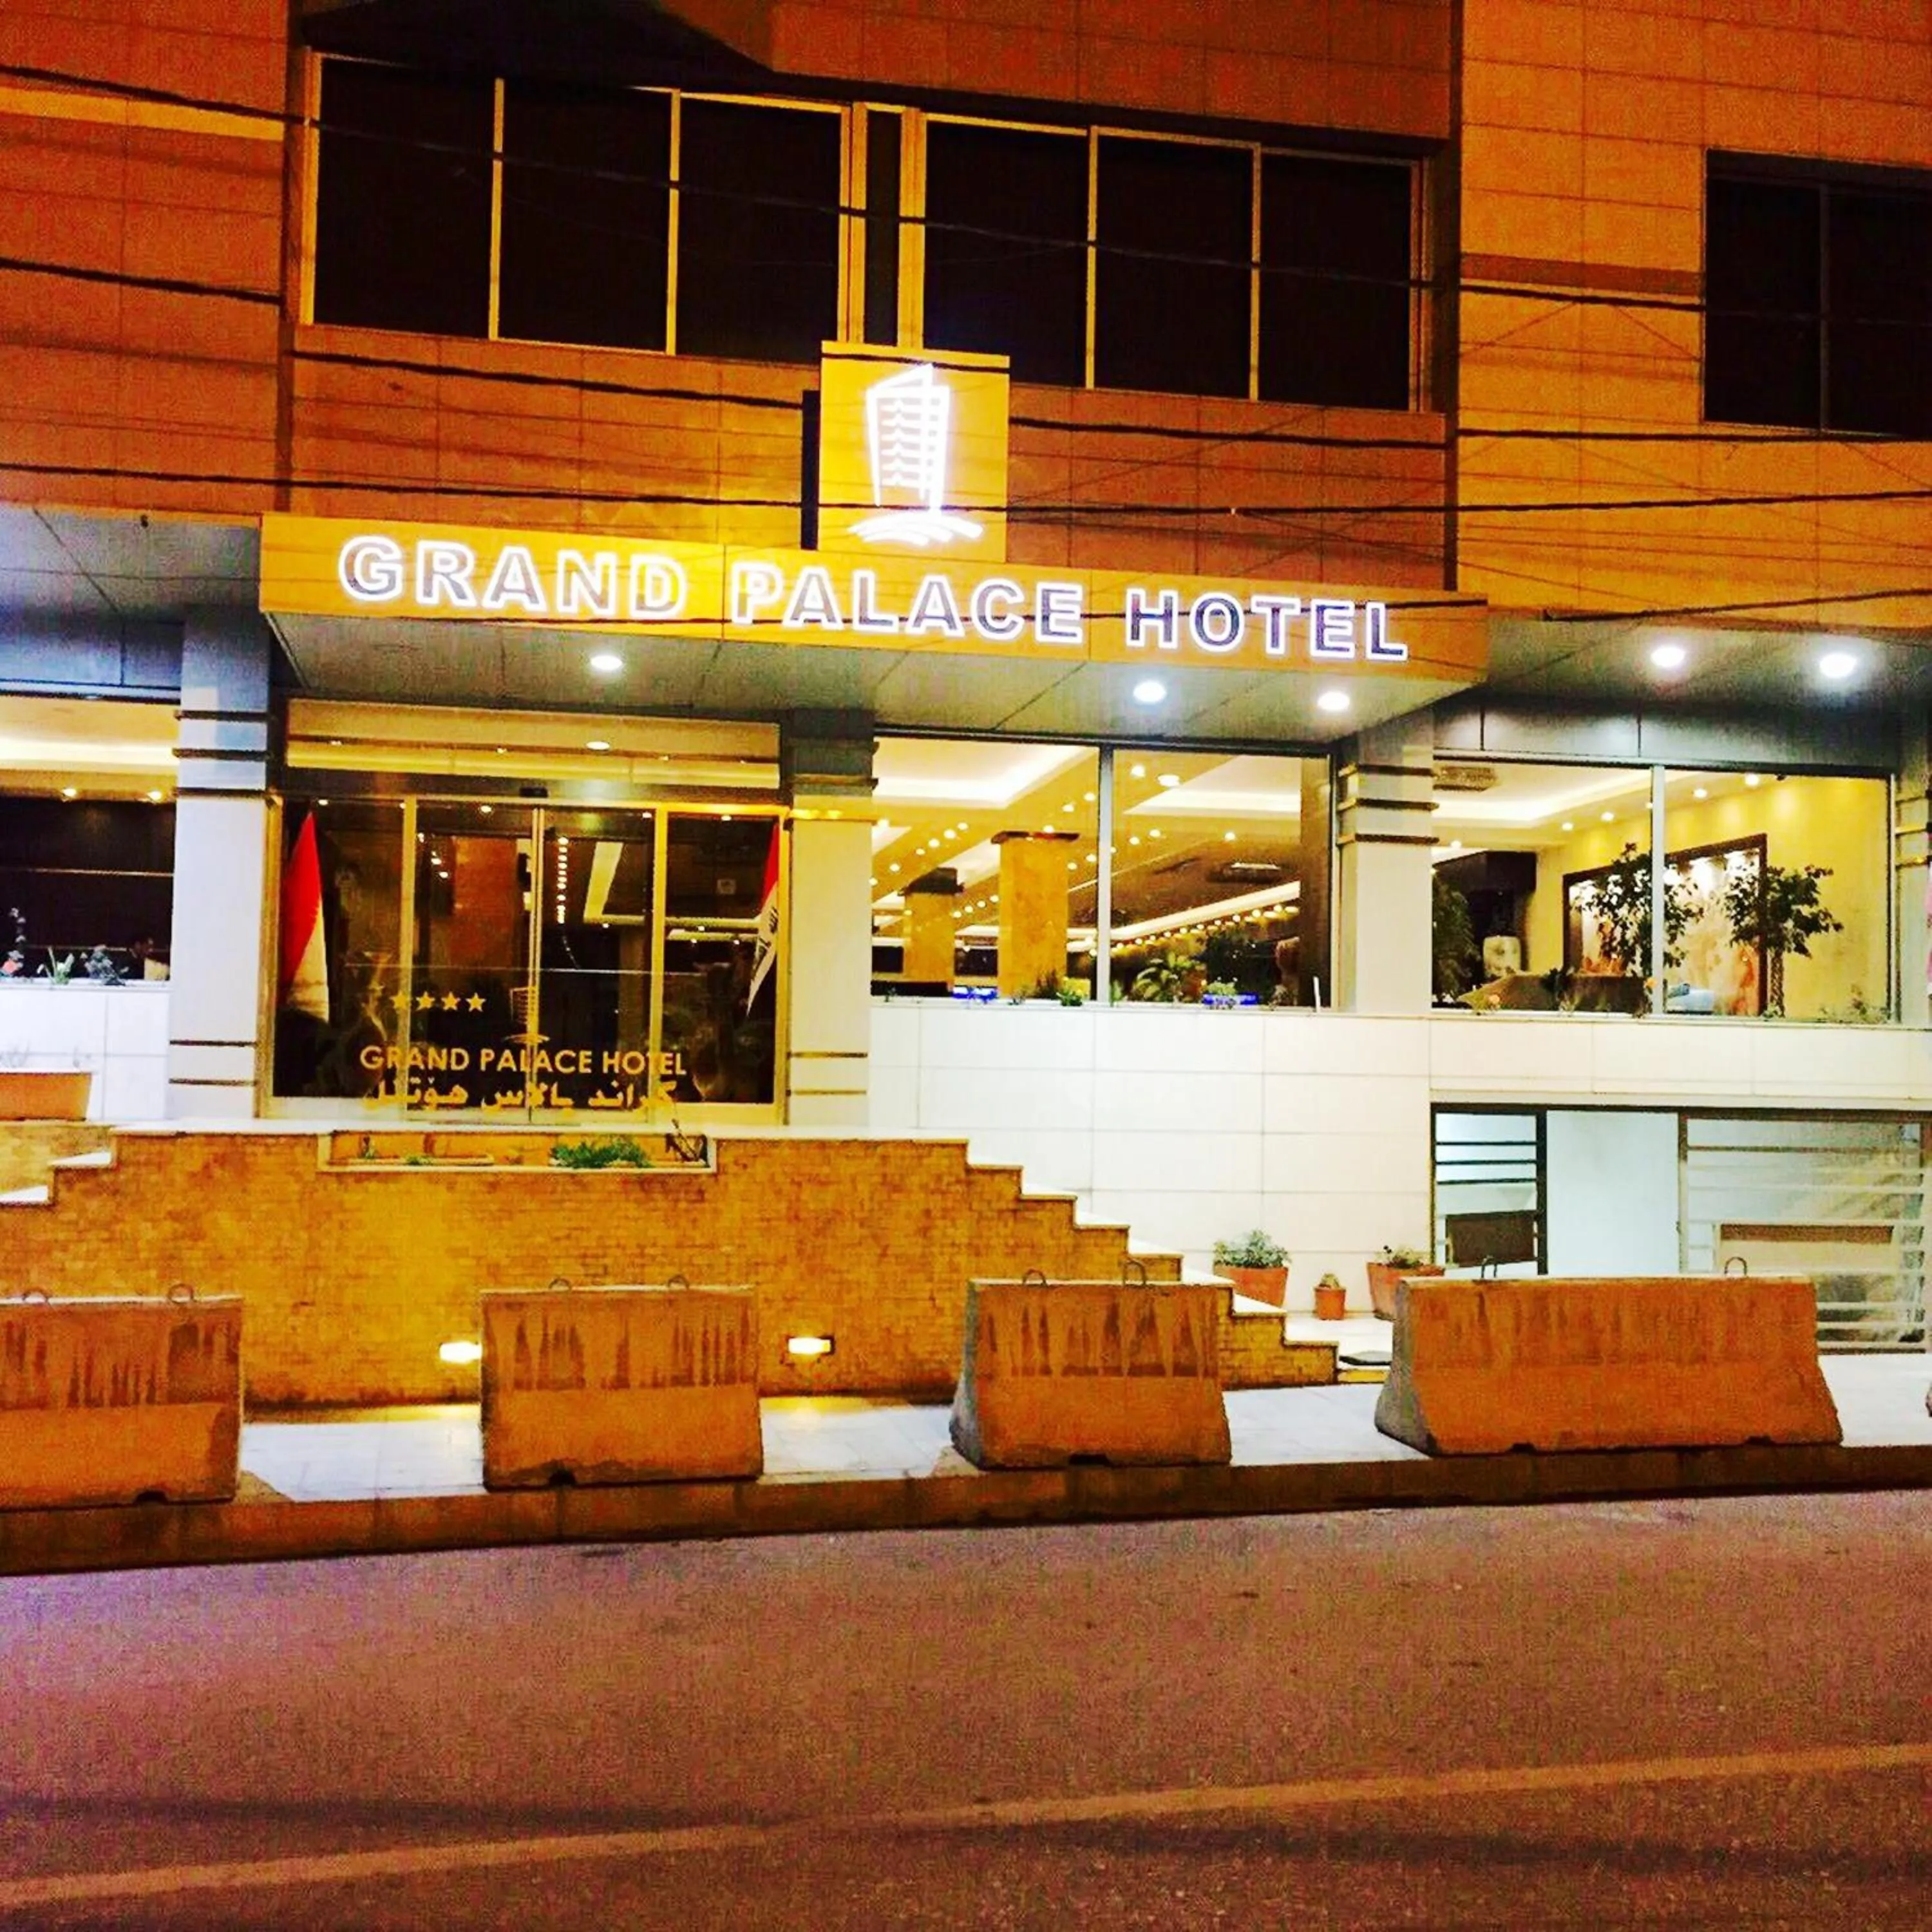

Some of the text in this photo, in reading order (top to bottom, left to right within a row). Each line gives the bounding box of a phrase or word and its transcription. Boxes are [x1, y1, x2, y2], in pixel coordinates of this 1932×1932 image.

[339, 535, 1408, 661] GRAND PALACE HOTEL
[360, 1045, 687, 1075] GRAND PALACE HOTEL
